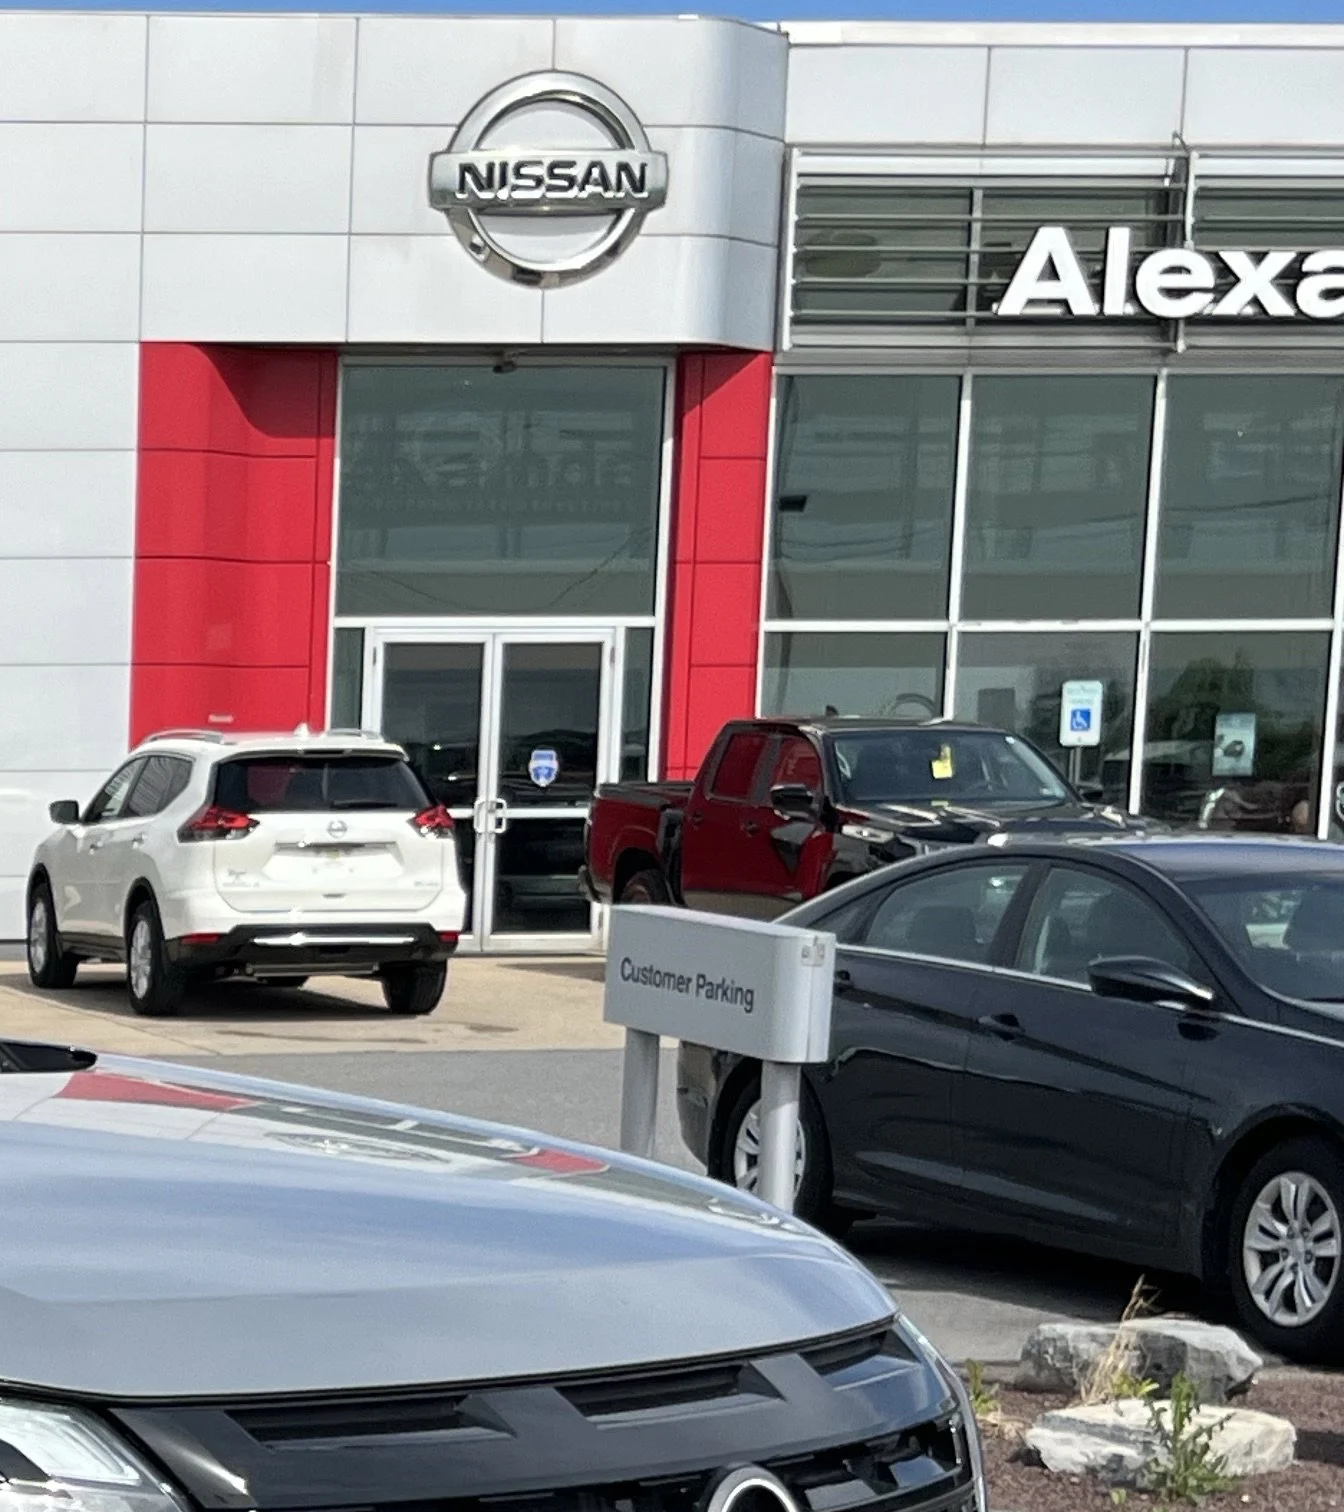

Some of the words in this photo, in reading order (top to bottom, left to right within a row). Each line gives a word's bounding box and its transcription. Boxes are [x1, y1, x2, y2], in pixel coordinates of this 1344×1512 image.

[457, 159, 649, 199] NISSAN
[996, 226, 1344, 318] Alexa
[620, 957, 693, 993] Customer
[695, 973, 755, 1014] Parking
